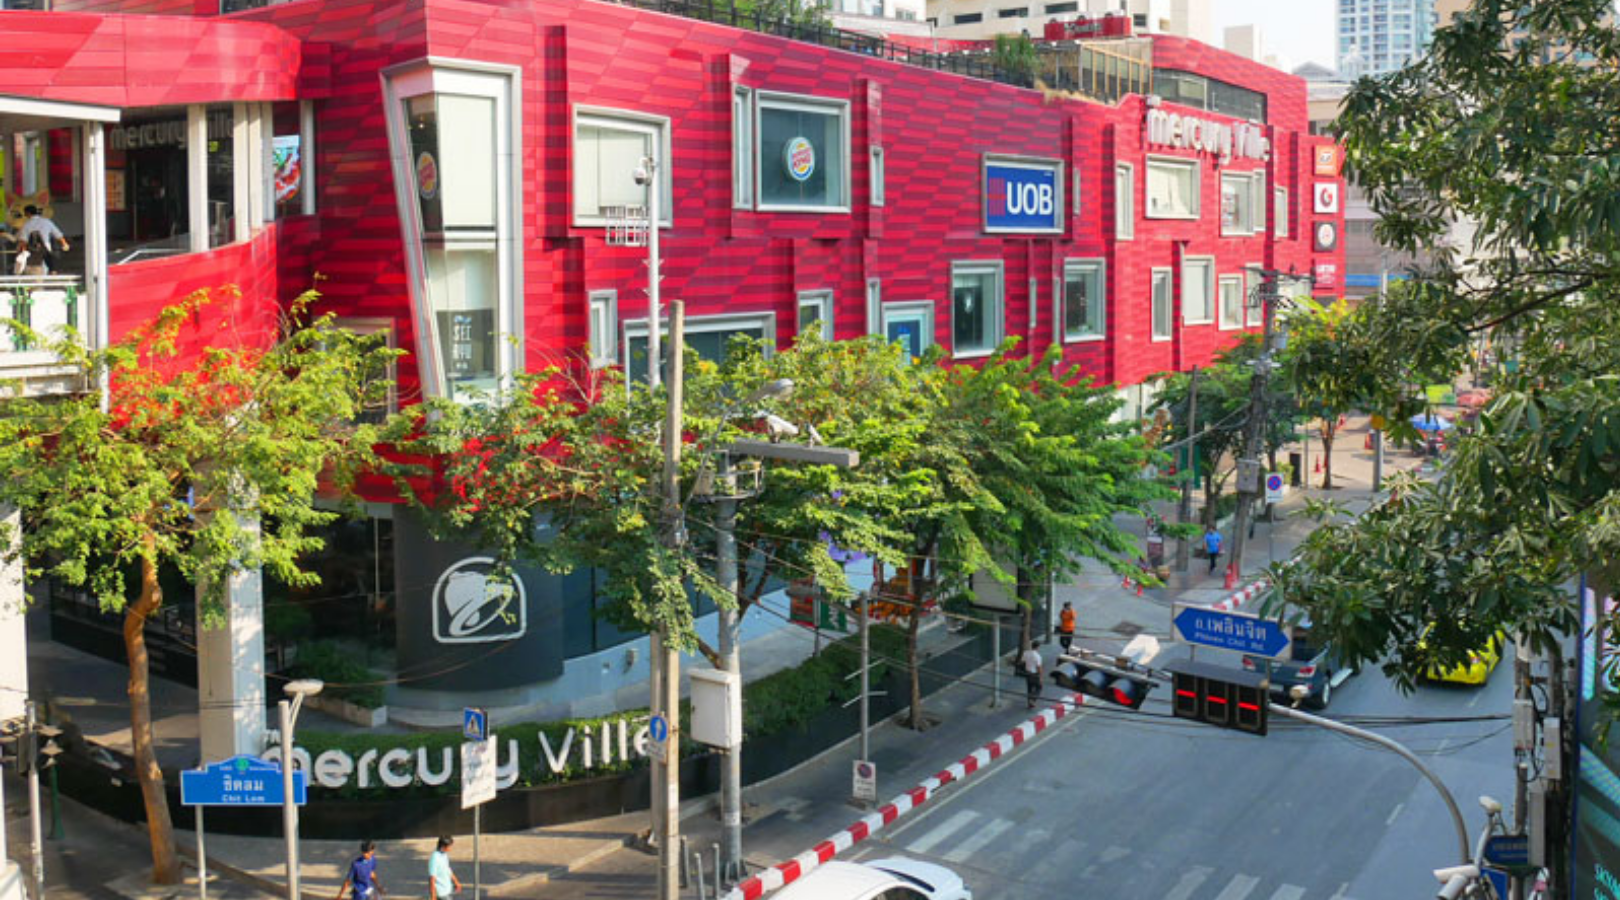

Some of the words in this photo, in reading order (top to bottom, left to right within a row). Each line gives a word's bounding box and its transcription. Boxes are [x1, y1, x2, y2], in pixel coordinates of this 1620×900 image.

[1147, 108, 1232, 165] mercury
[1006, 181, 1053, 215] UOB
[259, 739, 519, 791] mercuy
[222, 794, 242, 803] Chit
[223, 773, 265, 792] ชิดลม
